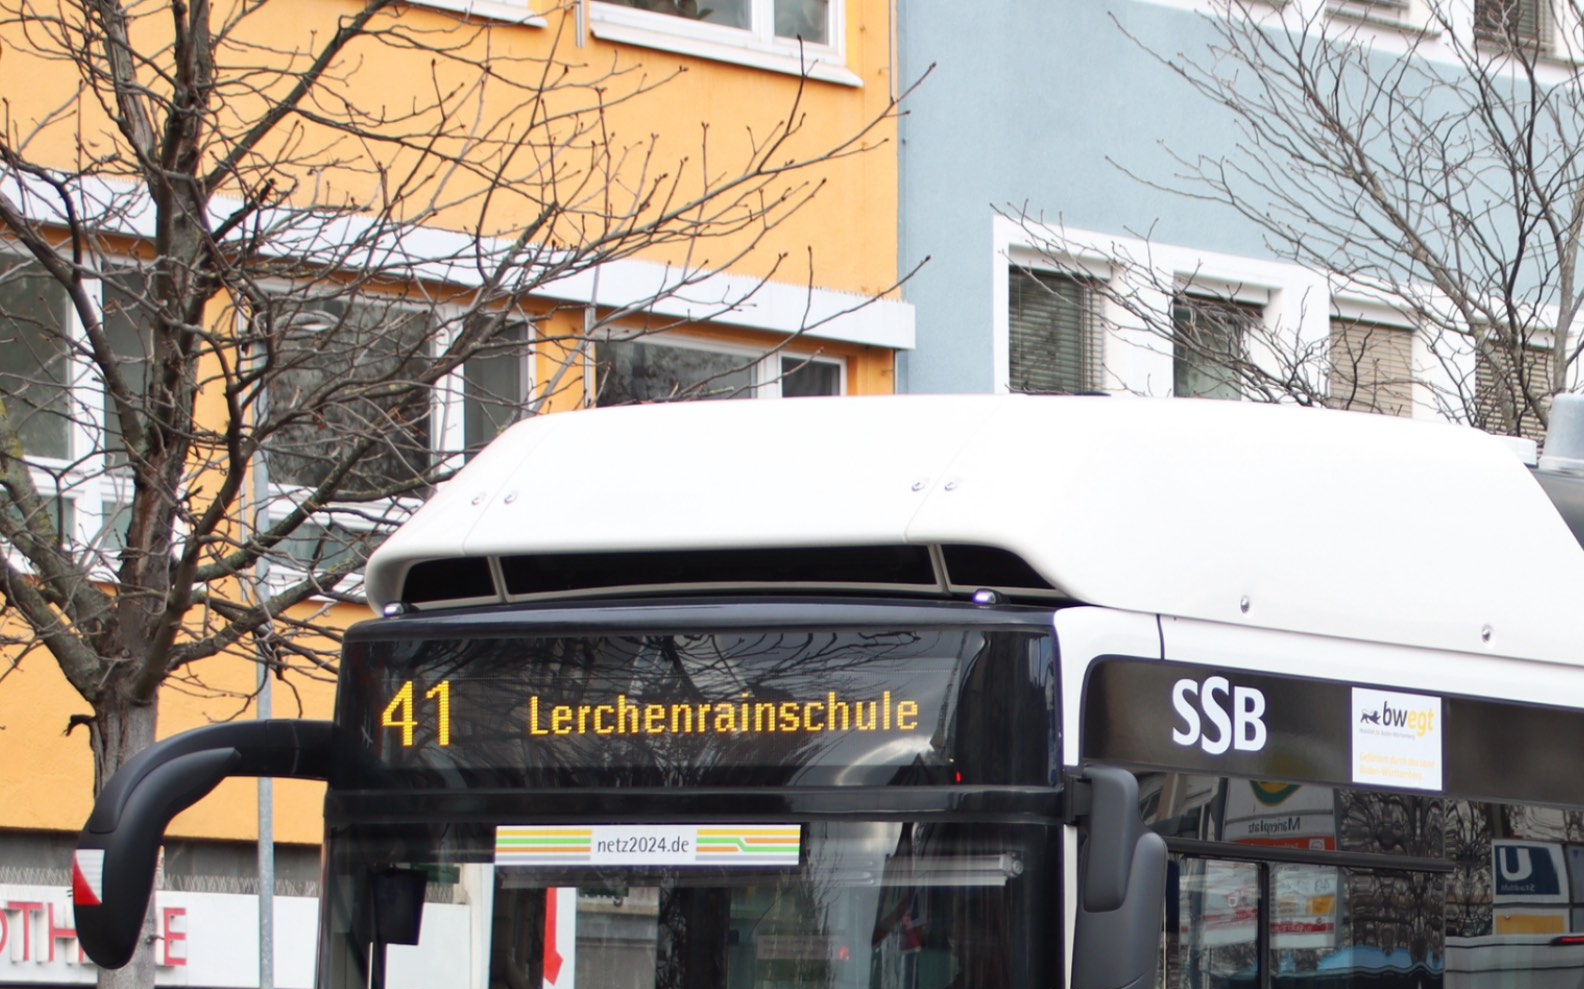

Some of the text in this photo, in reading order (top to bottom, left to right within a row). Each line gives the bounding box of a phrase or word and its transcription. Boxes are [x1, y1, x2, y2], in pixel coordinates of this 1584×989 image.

[382, 679, 919, 746] 41 Lerchenrainschule
[1172, 676, 1267, 755] SSB
[1382, 700, 1435, 737] bwegt
[597, 835, 689, 853] netz2024.de
